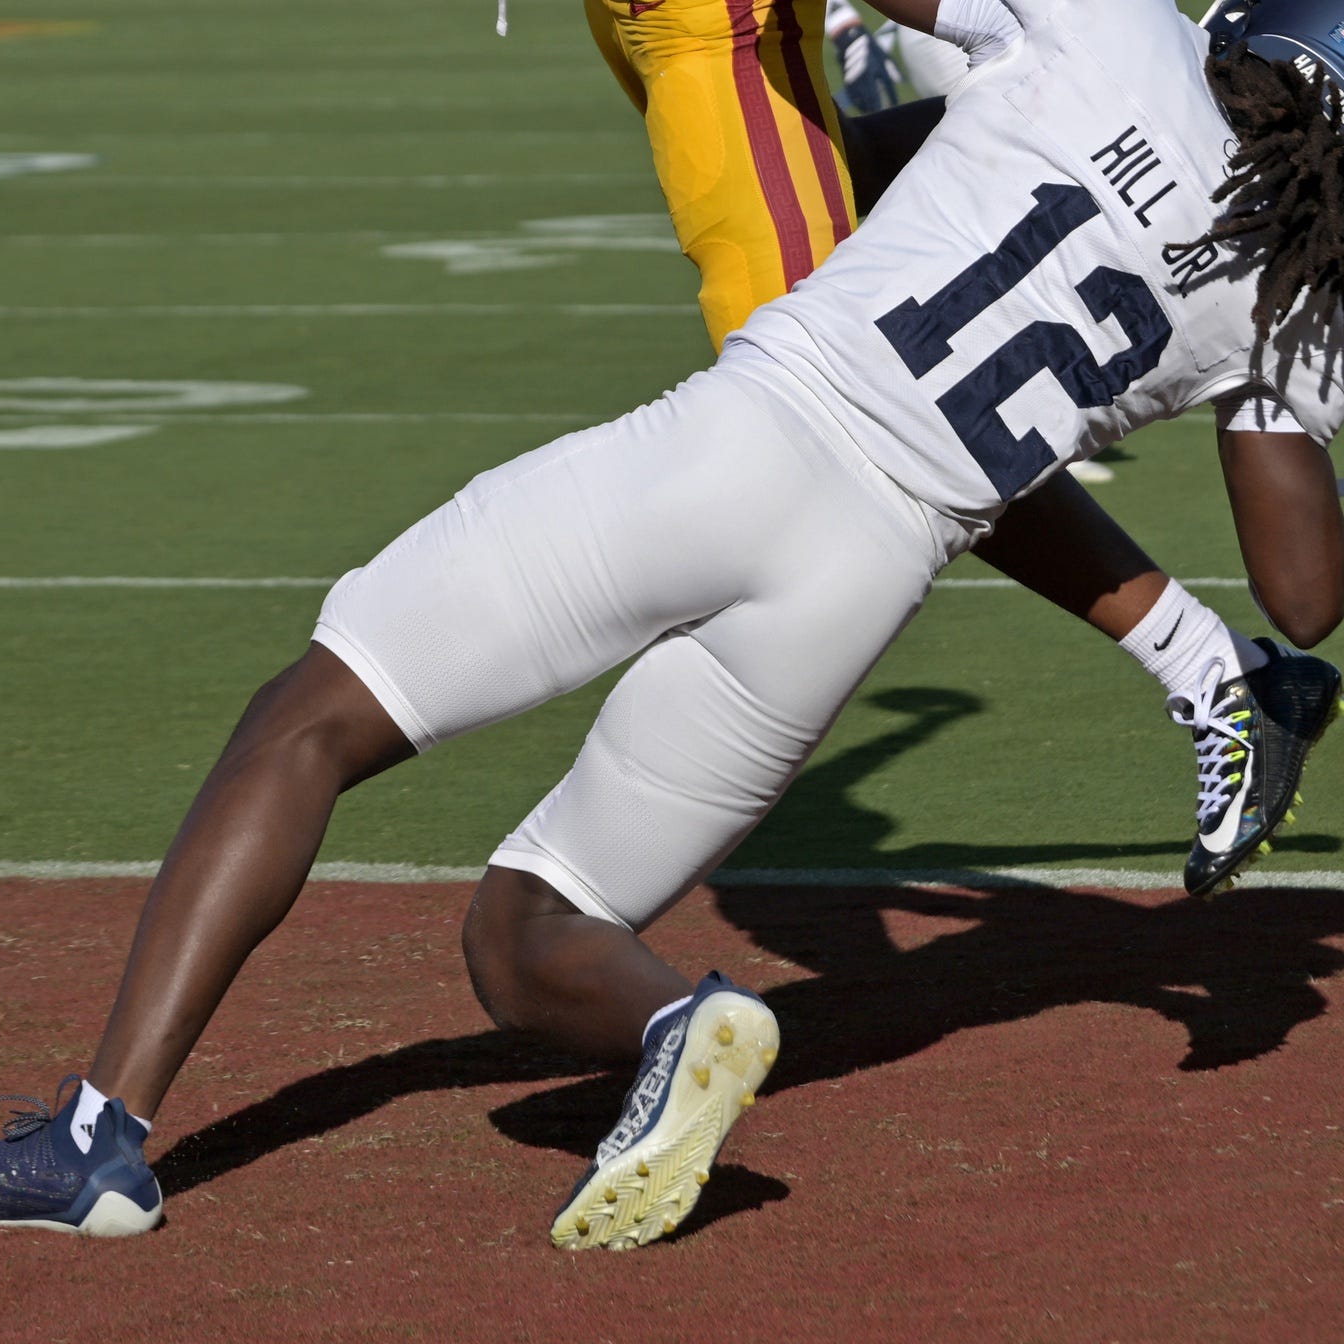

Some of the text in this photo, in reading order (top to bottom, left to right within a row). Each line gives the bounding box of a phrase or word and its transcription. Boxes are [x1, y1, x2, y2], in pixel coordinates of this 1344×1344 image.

[1090, 124, 1219, 299] HILL JR
[874, 182, 1173, 502] 12
